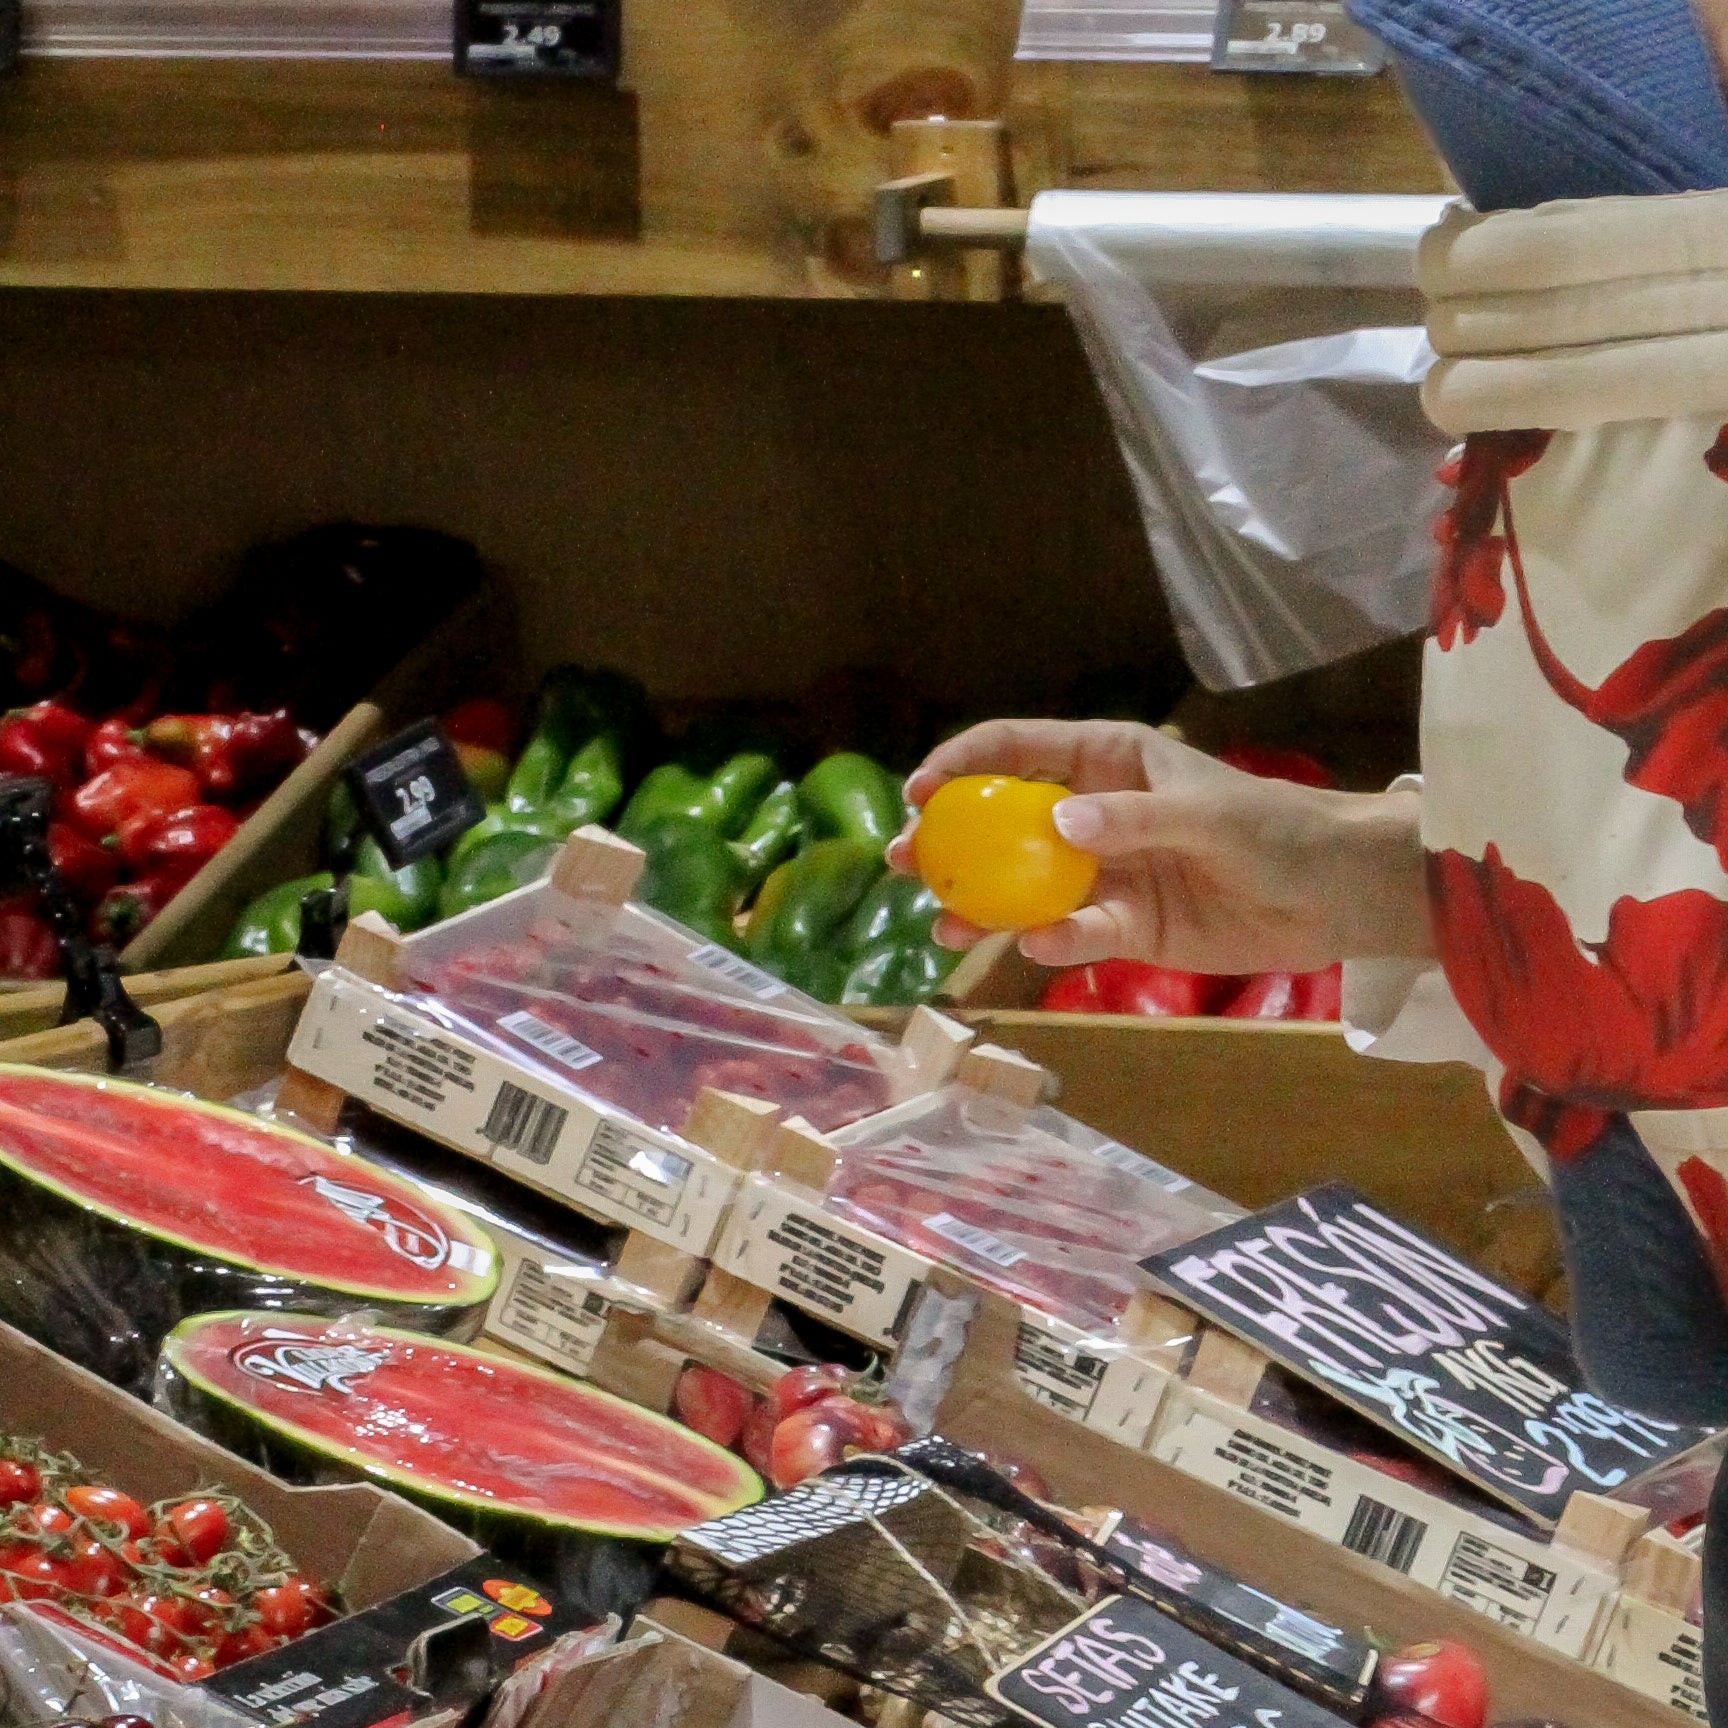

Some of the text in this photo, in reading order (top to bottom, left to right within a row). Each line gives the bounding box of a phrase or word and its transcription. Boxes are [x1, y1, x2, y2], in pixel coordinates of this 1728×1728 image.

[1169, 1196, 1529, 1375] FRESÓN
[1432, 1339, 1570, 1418] 1KG
[1020, 1617, 1167, 1715] SETAS
